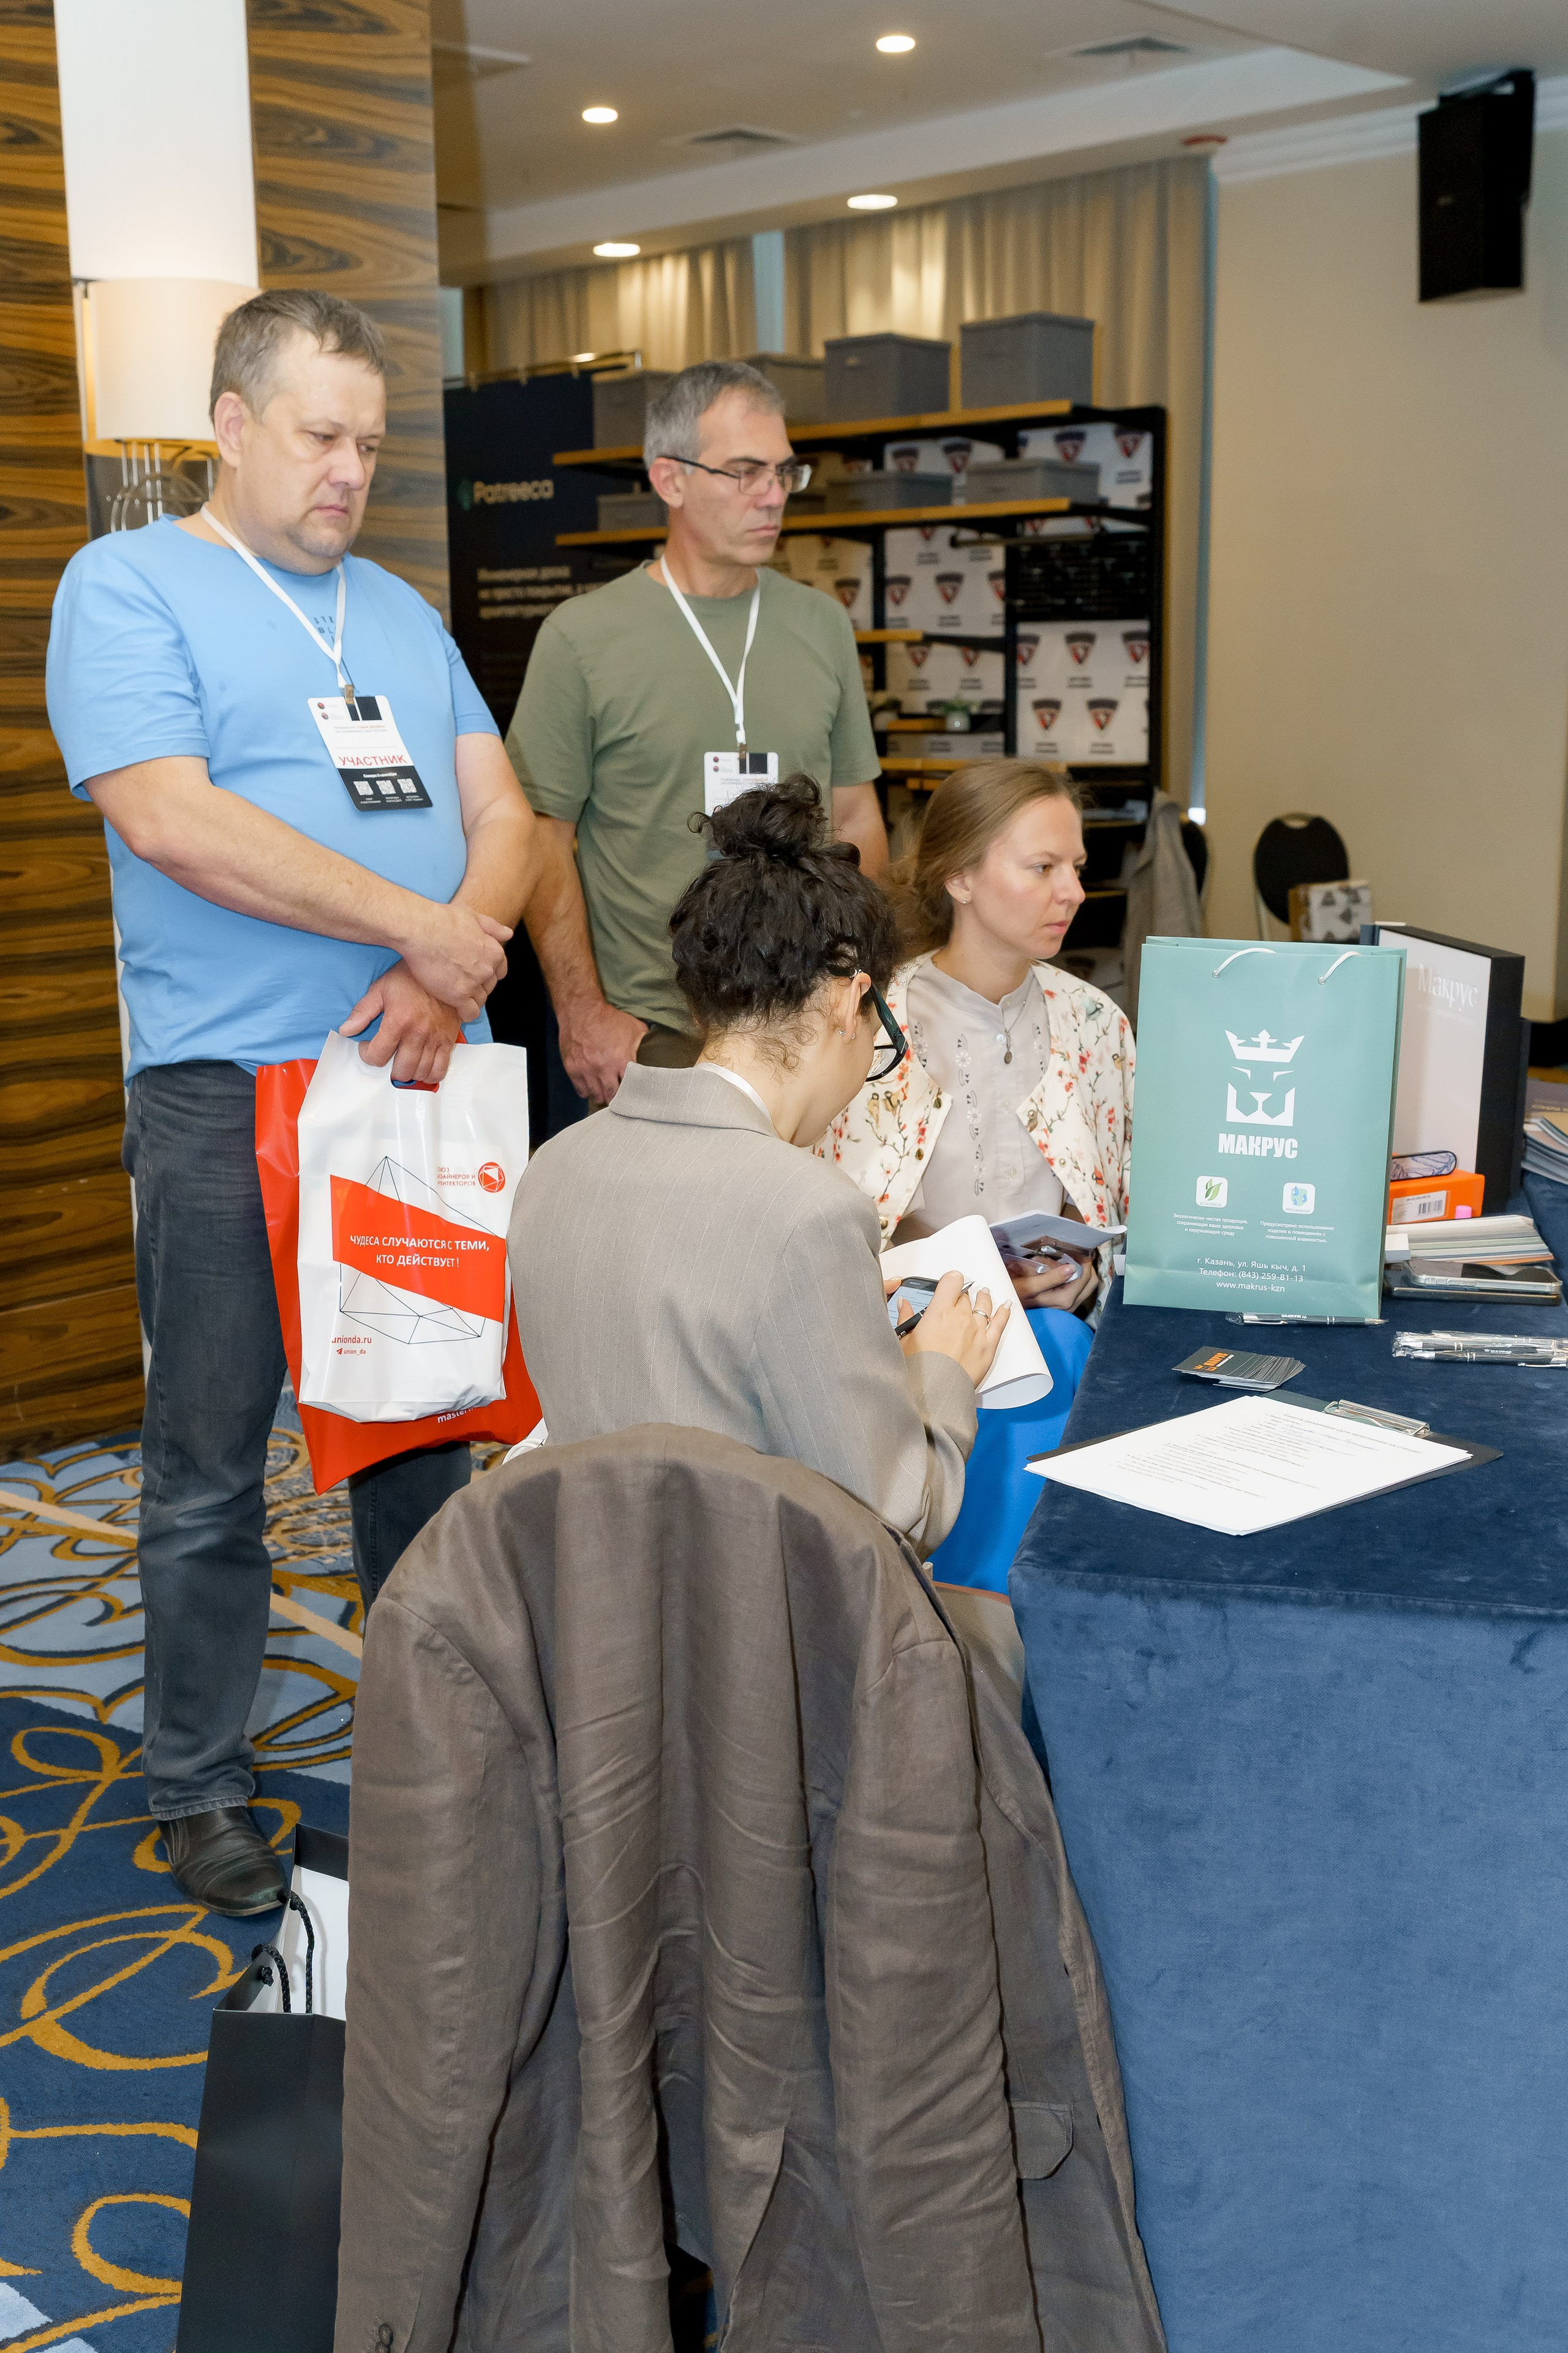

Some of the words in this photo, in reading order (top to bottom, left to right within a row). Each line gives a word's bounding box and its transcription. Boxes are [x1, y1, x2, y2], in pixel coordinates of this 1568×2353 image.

[339, 755, 407, 766] УЧАСТНИК
[1218, 1133, 1298, 1159] МАКРУС
[350, 1235, 380, 1247] ЧУДЕСА
[382, 1236, 447, 1249] СЛУЧАЮТСЯ
[454, 1241, 489, 1252] ТЕМИ,
[376, 1254, 394, 1264] КТО
[1205, 1258, 1235, 1267] Казань,
[1251, 1261, 1268, 1269] Яшь
[1199, 1268, 1236, 1278] Телефон:
[1238, 1271, 1259, 1280] (843)
[1261, 1272, 1303, 1282] 259-81-13
[1216, 1281, 1285, 1292] www.makrus-kzn
[331, 1335, 372, 1343] unionda.ru
